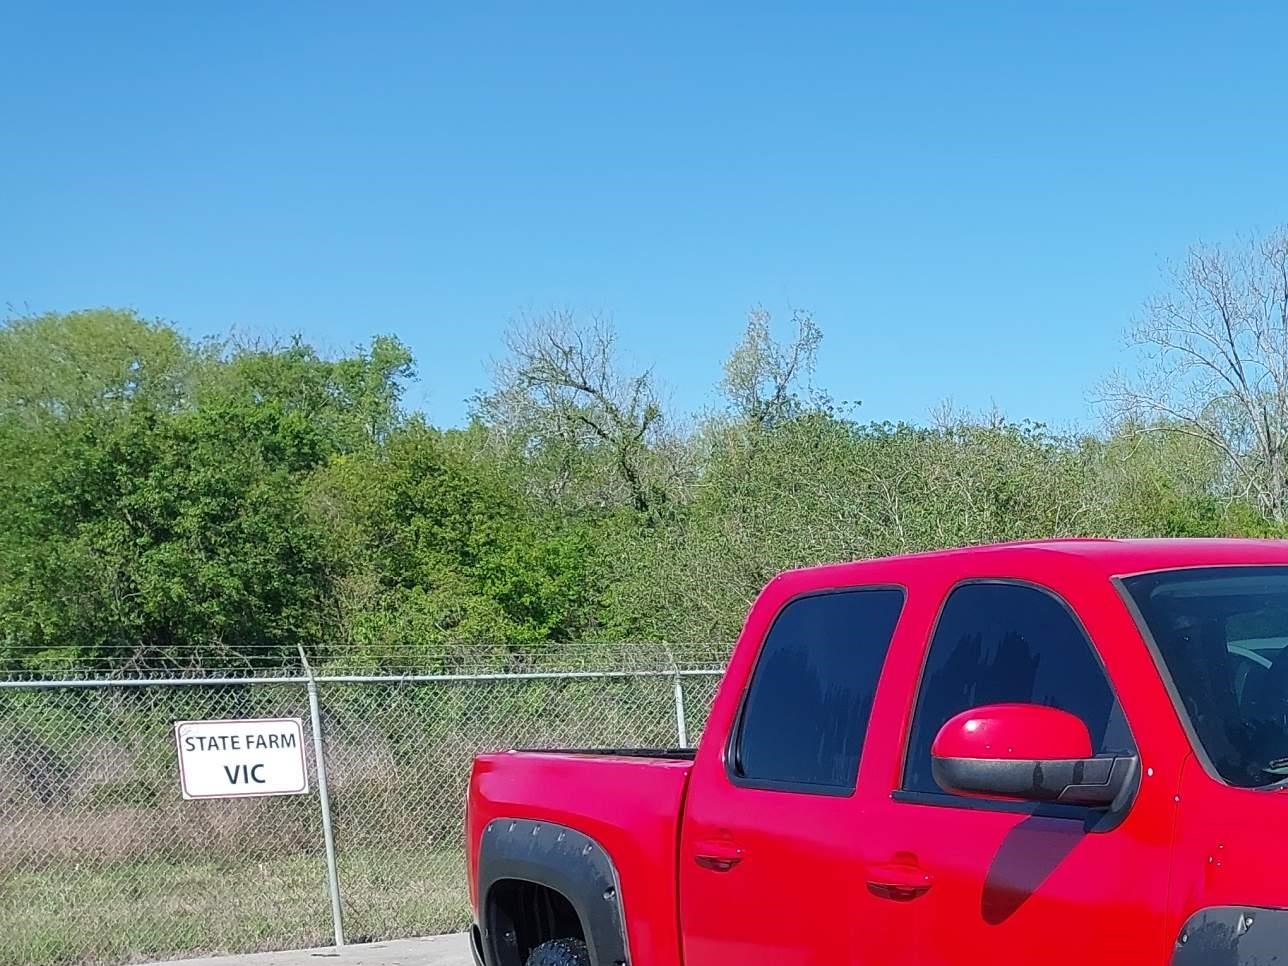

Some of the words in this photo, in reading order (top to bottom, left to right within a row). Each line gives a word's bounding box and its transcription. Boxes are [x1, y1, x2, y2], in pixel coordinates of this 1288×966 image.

[185, 735, 241, 752] STATE
[245, 733, 297, 750] FARM
[223, 763, 266, 785] VIC
